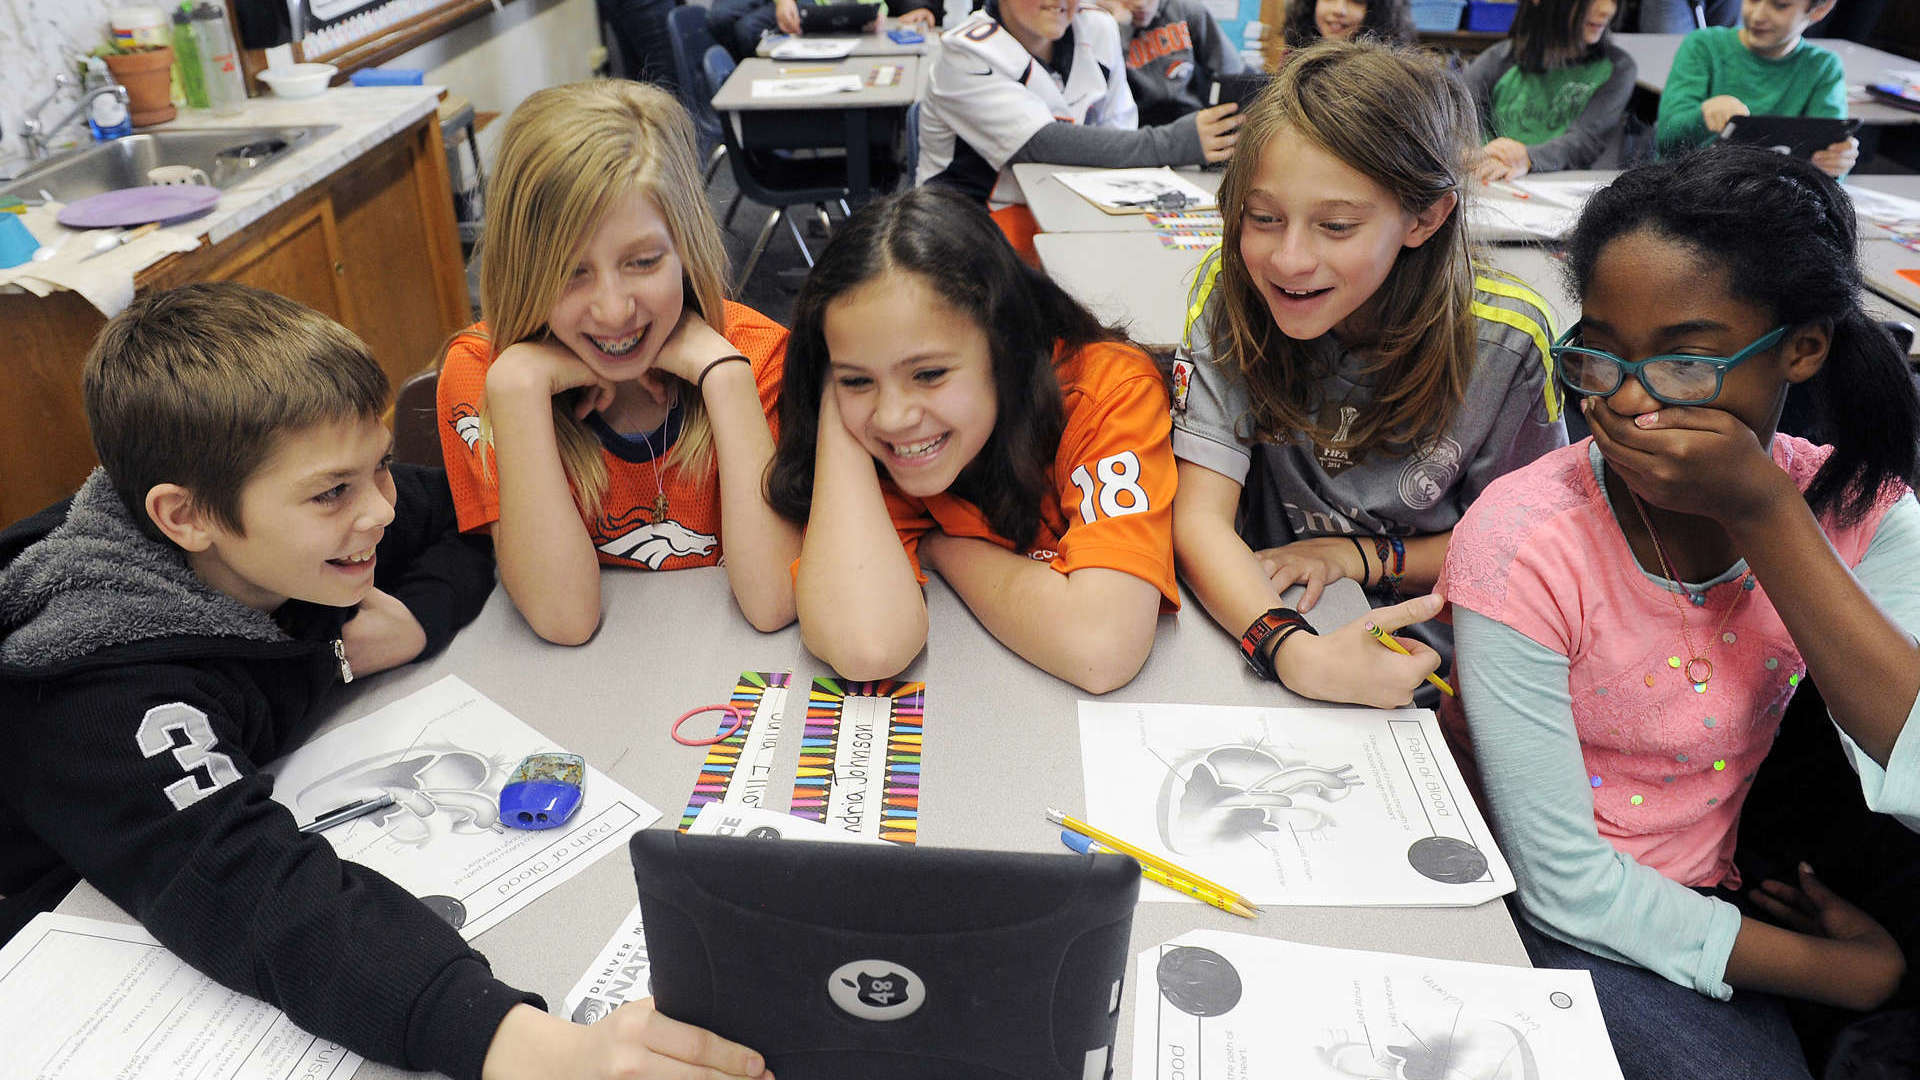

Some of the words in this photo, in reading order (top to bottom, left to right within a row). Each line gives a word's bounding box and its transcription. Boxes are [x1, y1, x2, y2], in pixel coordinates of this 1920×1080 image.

[1071, 450, 1149, 525] 18
[135, 702, 243, 811] 3
[833, 723, 874, 787] Johnson
[1407, 737, 1427, 767] Path
[1425, 782, 1454, 817] Blood
[552, 847, 570, 862] of
[570, 822, 612, 848] Path
[497, 861, 549, 896] Blood
[590, 943, 632, 994] DENVER
[868, 979, 896, 1005] 48
